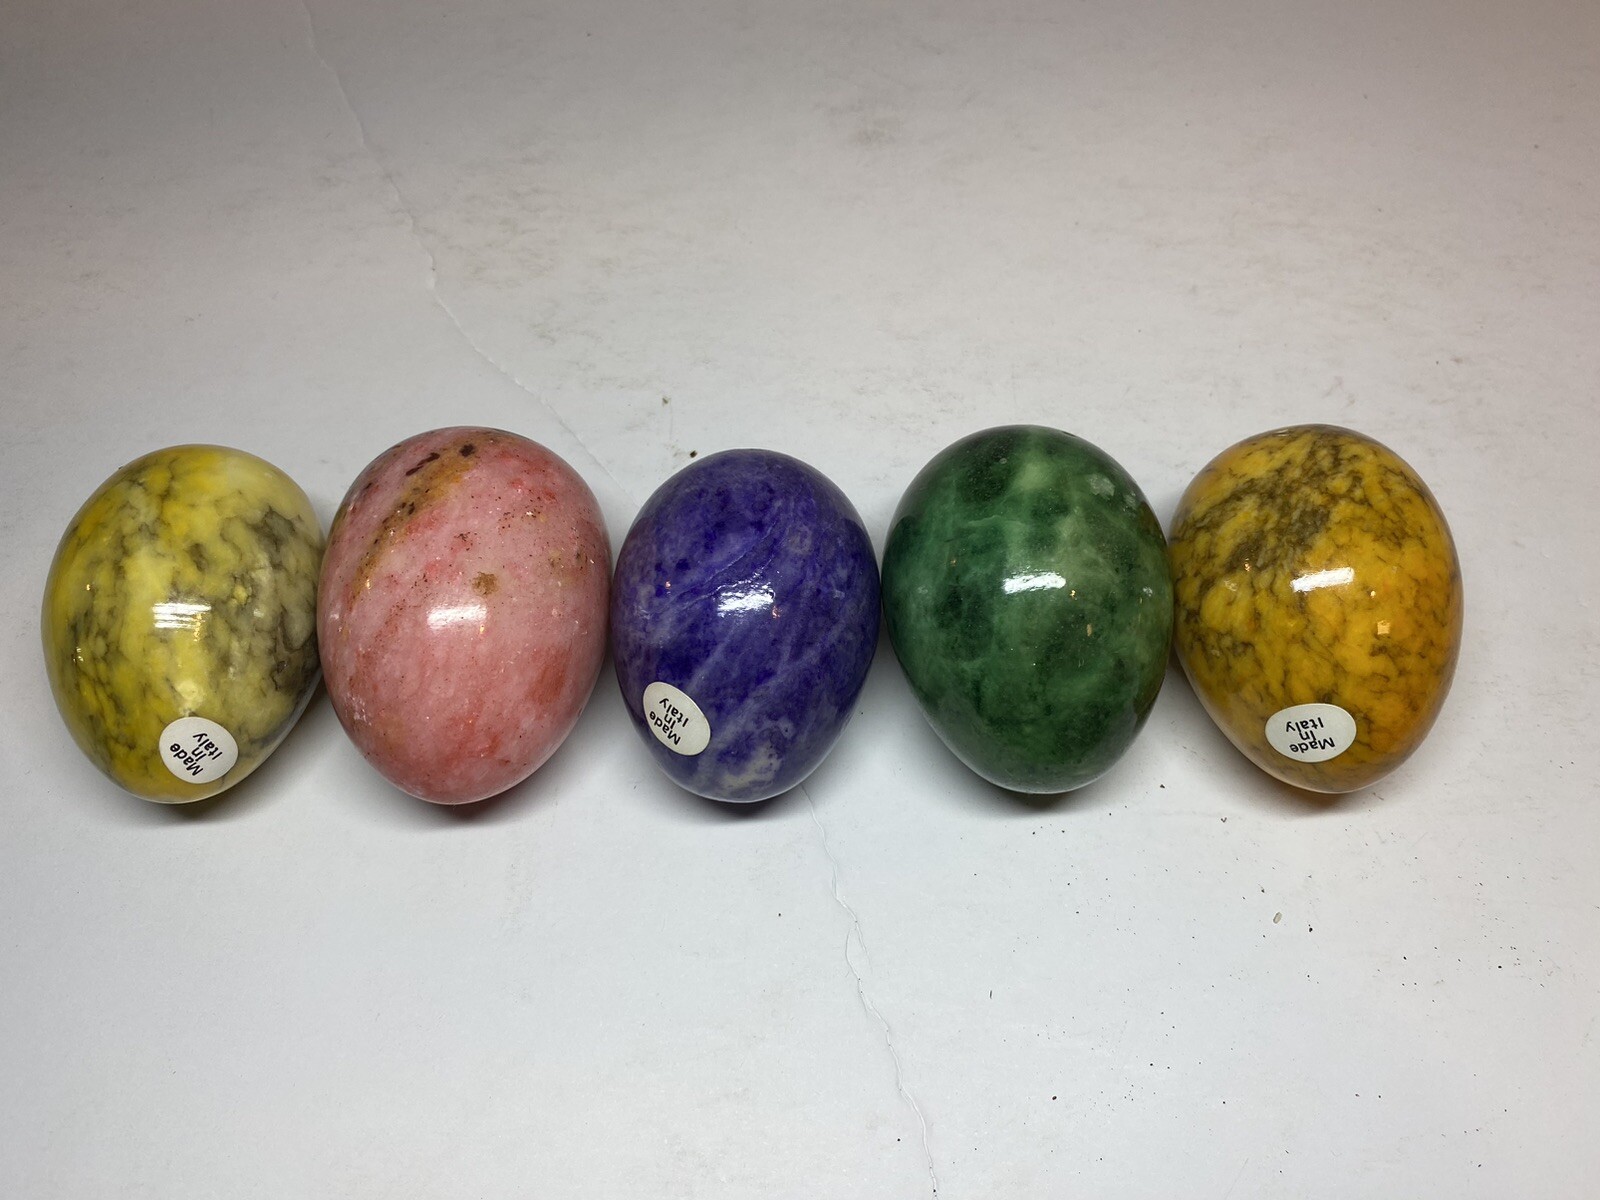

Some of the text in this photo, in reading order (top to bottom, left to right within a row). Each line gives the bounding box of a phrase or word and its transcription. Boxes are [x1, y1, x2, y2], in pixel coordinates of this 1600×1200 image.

[658, 697, 689, 728] Italy
[1285, 716, 1324, 732] Italy
[649, 710, 681, 746] Made
[192, 732, 223, 760] Italy
[1289, 736, 1336, 753] Made
[169, 743, 204, 776] Made
